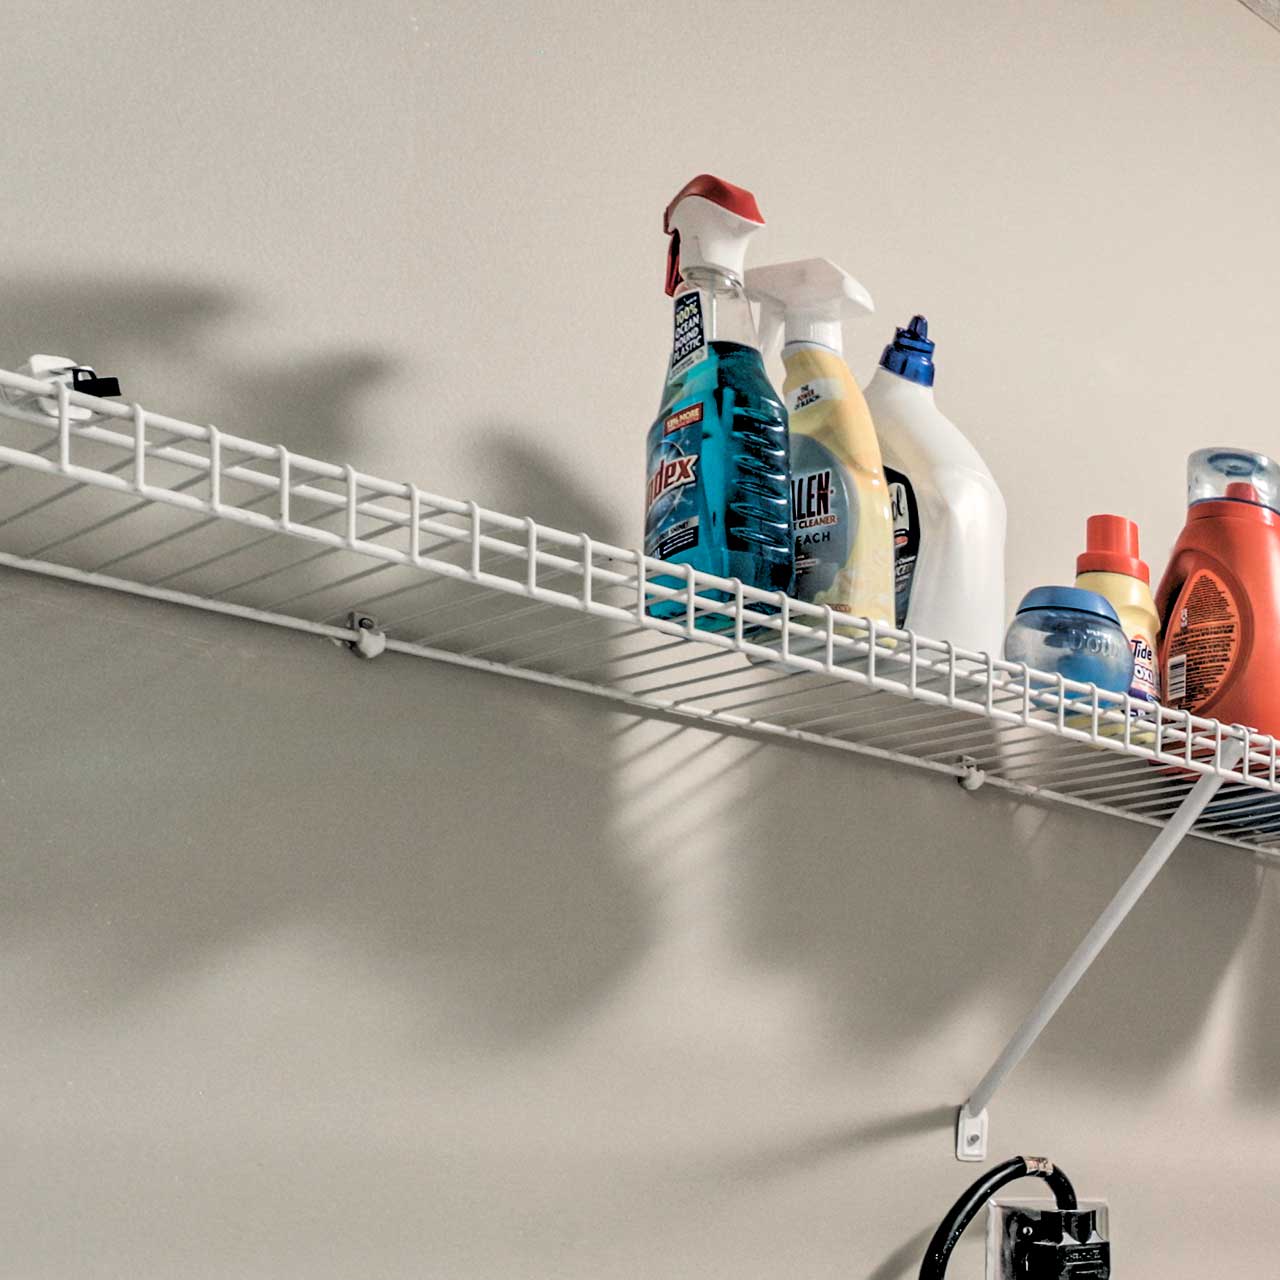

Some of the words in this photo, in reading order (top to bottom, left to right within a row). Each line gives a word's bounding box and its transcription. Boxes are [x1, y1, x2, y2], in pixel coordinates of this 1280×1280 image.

[675, 314, 700, 338] OCEAN
[673, 335, 702, 364] PLASTIC
[799, 515, 836, 529] CLEANER
[1131, 640, 1153, 661] Tide
